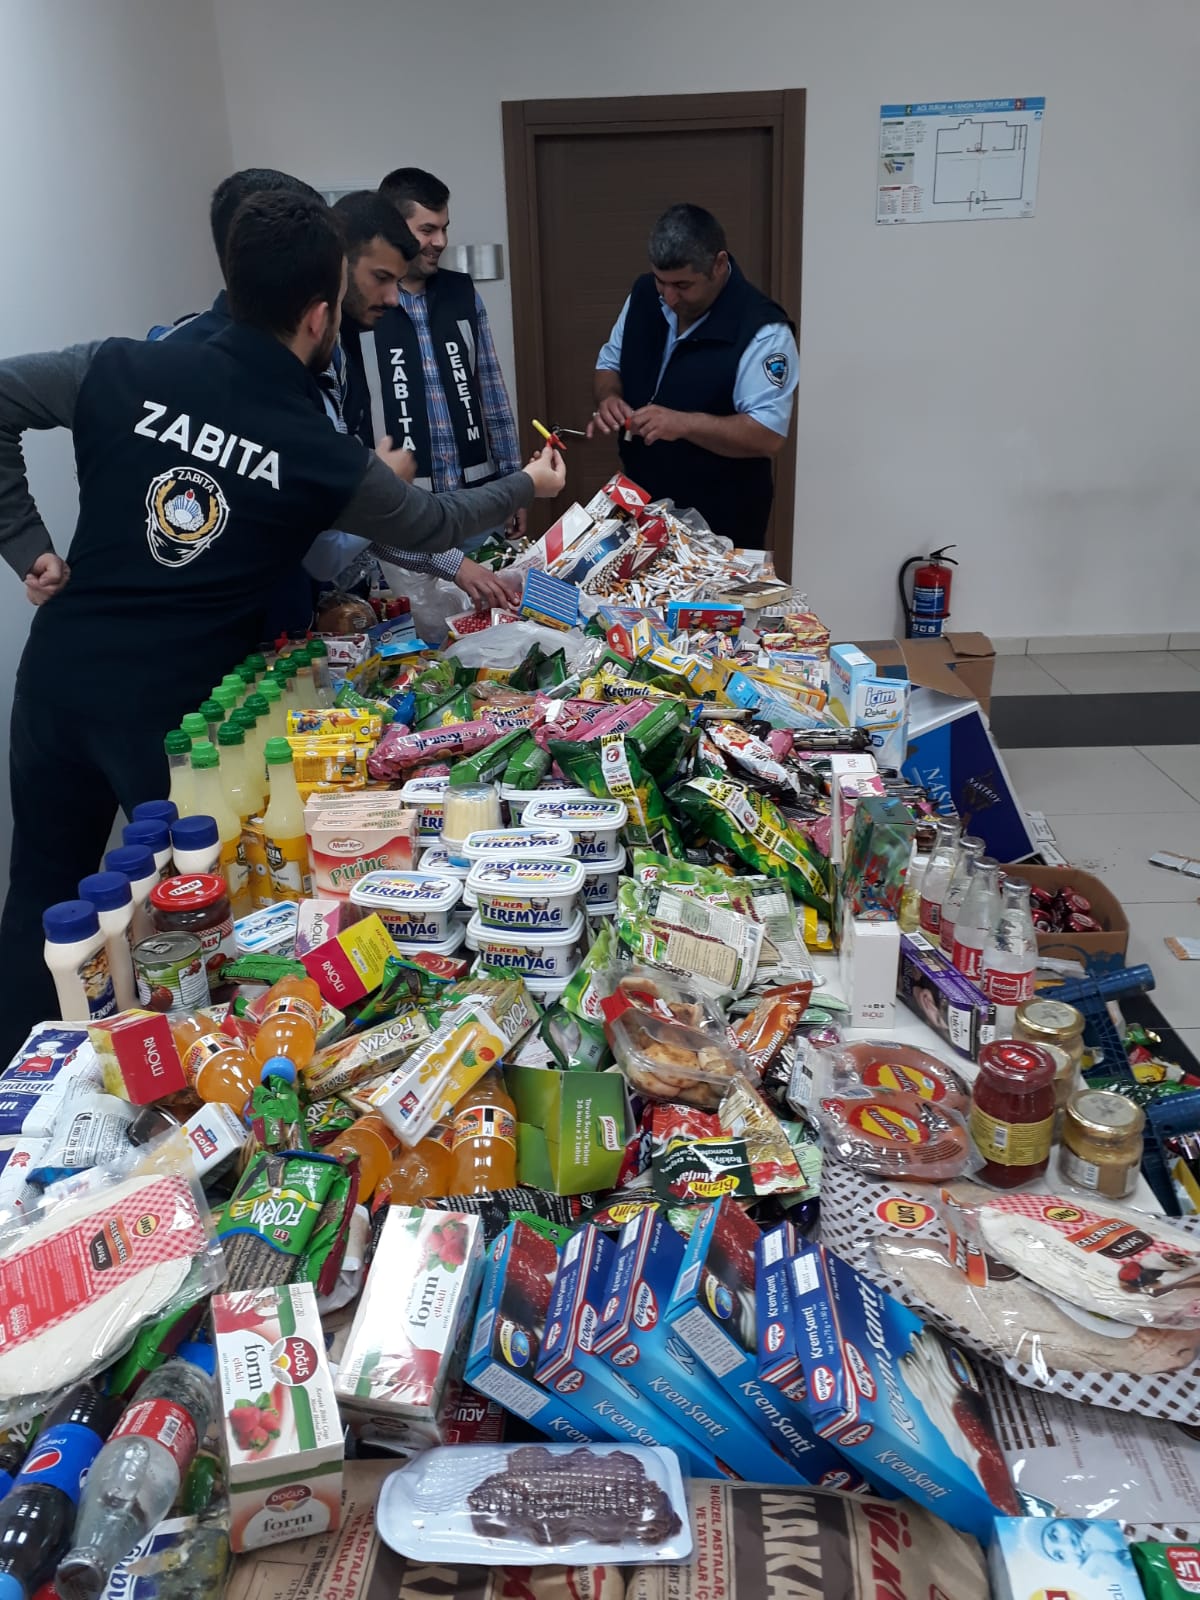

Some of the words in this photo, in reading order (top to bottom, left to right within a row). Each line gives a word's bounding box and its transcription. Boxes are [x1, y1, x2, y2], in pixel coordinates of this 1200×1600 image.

[389, 348, 416, 451] ZABITA
[133, 400, 281, 491] ZABITA
[177, 470, 215, 494] ZABITA
[967, 776, 1001, 803] NASTROY
[359, 1015, 416, 1054] FORM
[193, 1131, 213, 1154] Gold
[692, 1177, 735, 1195] Bizim
[138, 1216, 153, 1235] UNO
[250, 1198, 307, 1229] FORM
[409, 1275, 440, 1328] form
[244, 1343, 266, 1391] form
[293, 1341, 305, 1377] DOĞUŞ
[262, 1514, 313, 1533] form
[696, 1506, 706, 1520] VE
